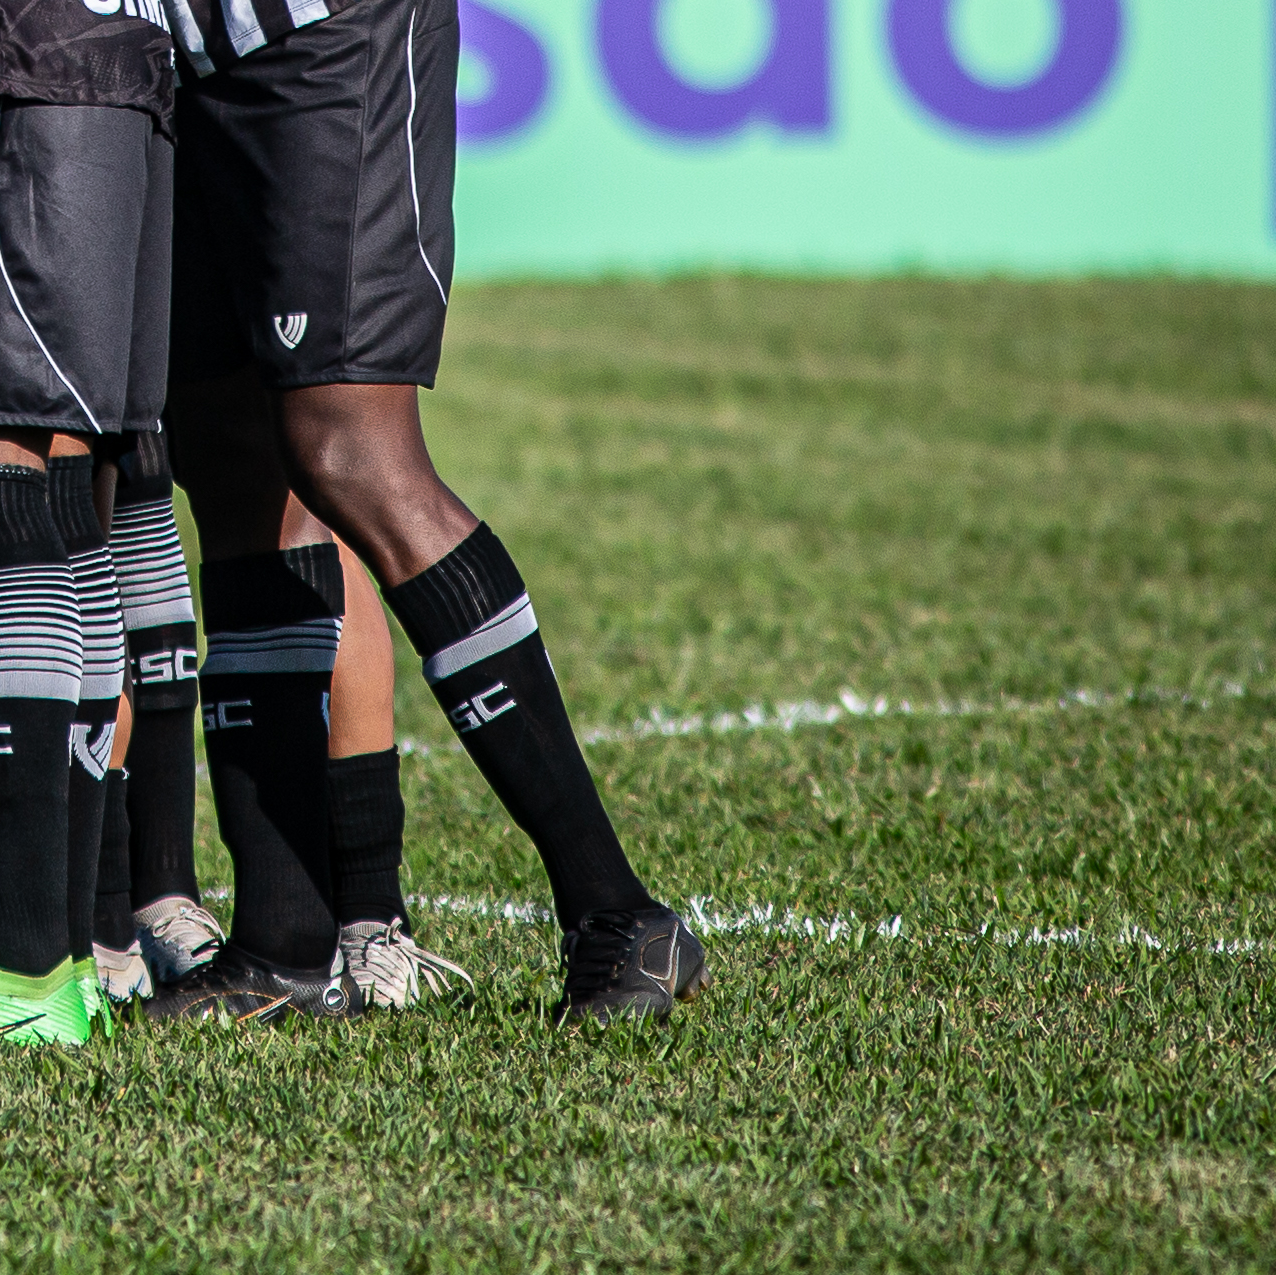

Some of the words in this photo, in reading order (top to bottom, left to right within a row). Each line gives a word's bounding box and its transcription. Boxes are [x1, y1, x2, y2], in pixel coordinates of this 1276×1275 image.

[128, 648, 198, 685] SC
[202, 699, 254, 732] SC
[449, 681, 517, 734] SC
